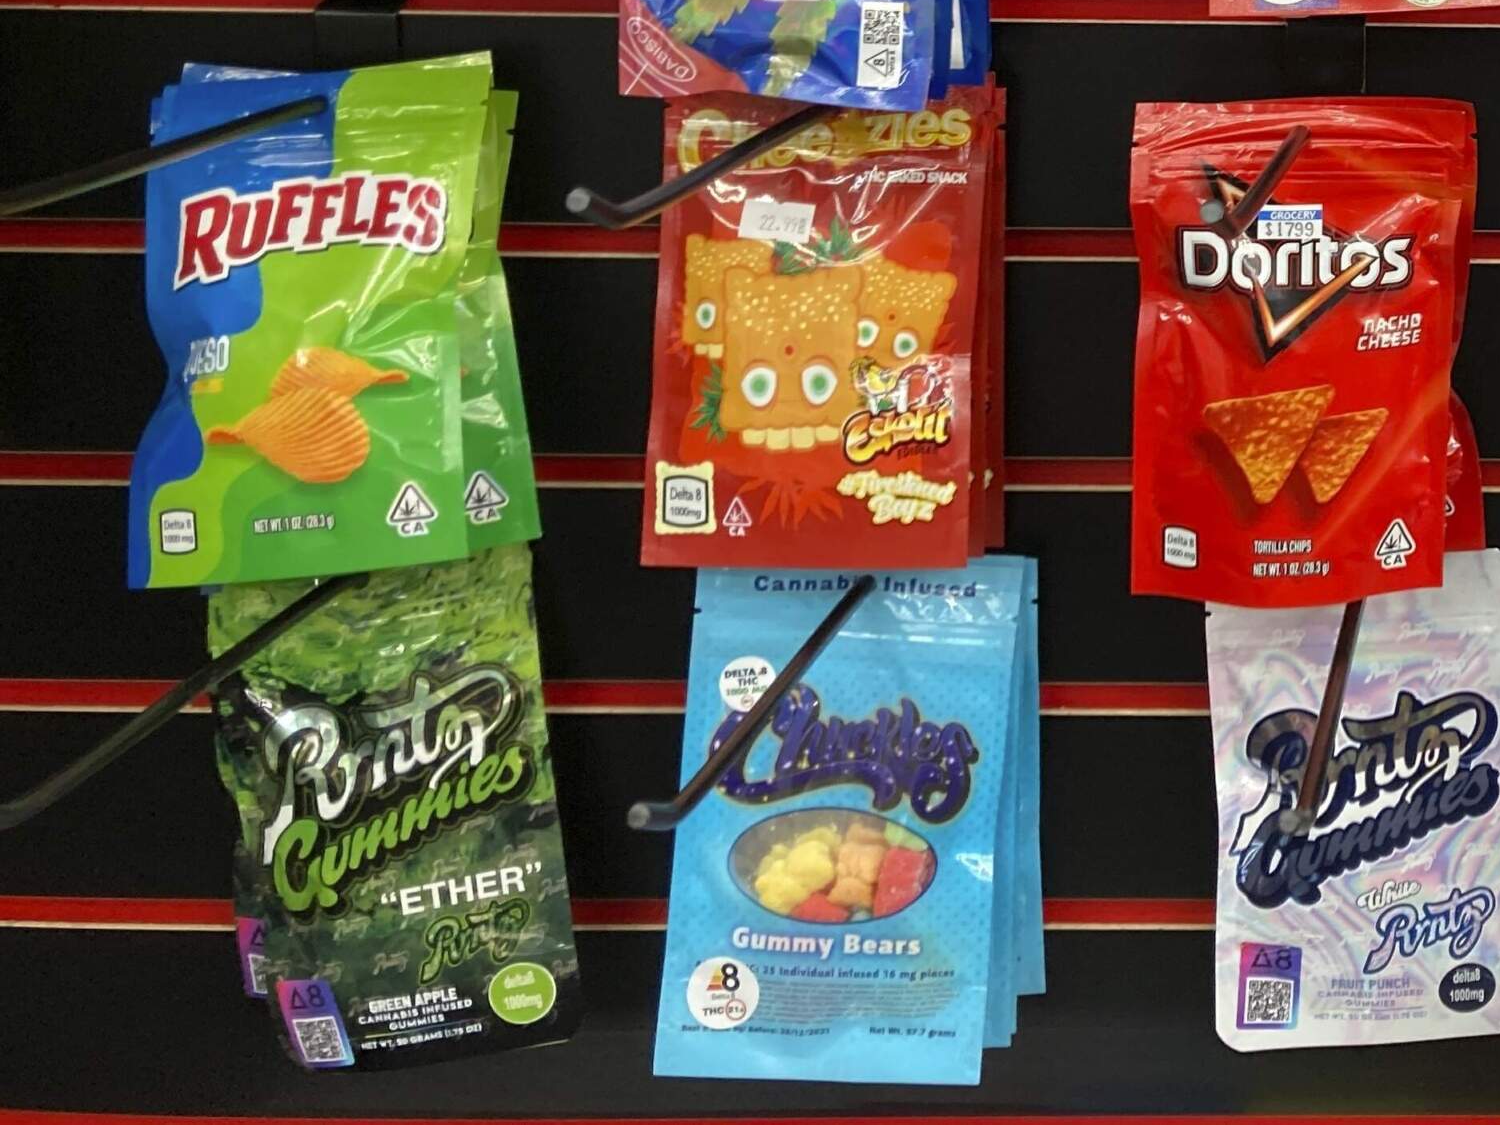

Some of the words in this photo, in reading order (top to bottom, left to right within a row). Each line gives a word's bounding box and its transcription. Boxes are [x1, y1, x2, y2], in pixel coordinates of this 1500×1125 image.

[927, 173, 967, 184] SNACK
[1270, 211, 1316, 220] GROCERY
[178, 176, 443, 283] RUFFLES
[1183, 230, 1411, 289] Doritos
[1357, 329, 1421, 351] CHEESE
[670, 486, 693, 500] Delta
[475, 507, 496, 520] CA
[401, 523, 424, 533] CA
[729, 526, 746, 536] CA
[1167, 533, 1188, 546] Delta
[1254, 541, 1288, 554] TORTILLA
[1289, 539, 1312, 553] CHIPS
[1383, 555, 1403, 566] CA
[1253, 564, 1267, 577] NET
[883, 576, 977, 598] Infused
[724, 667, 756, 679] DELTA
[737, 678, 758, 687] THC
[274, 746, 526, 910] Gummies
[732, 927, 835, 960] Gummy
[843, 934, 922, 957] Bears
[719, 962, 741, 992] 8
[1331, 979, 1365, 990] FRUIT
[1369, 978, 1410, 989] PUNCH
[368, 995, 413, 1014] GREEN
[414, 987, 458, 1007] APPLE
[1450, 988, 1485, 1003] 1000mg
[358, 1010, 419, 1025] CANNABIS
[422, 999, 473, 1015] INFUSED
[702, 1006, 724, 1017] THC
[389, 1014, 445, 1031] GUMMIES
